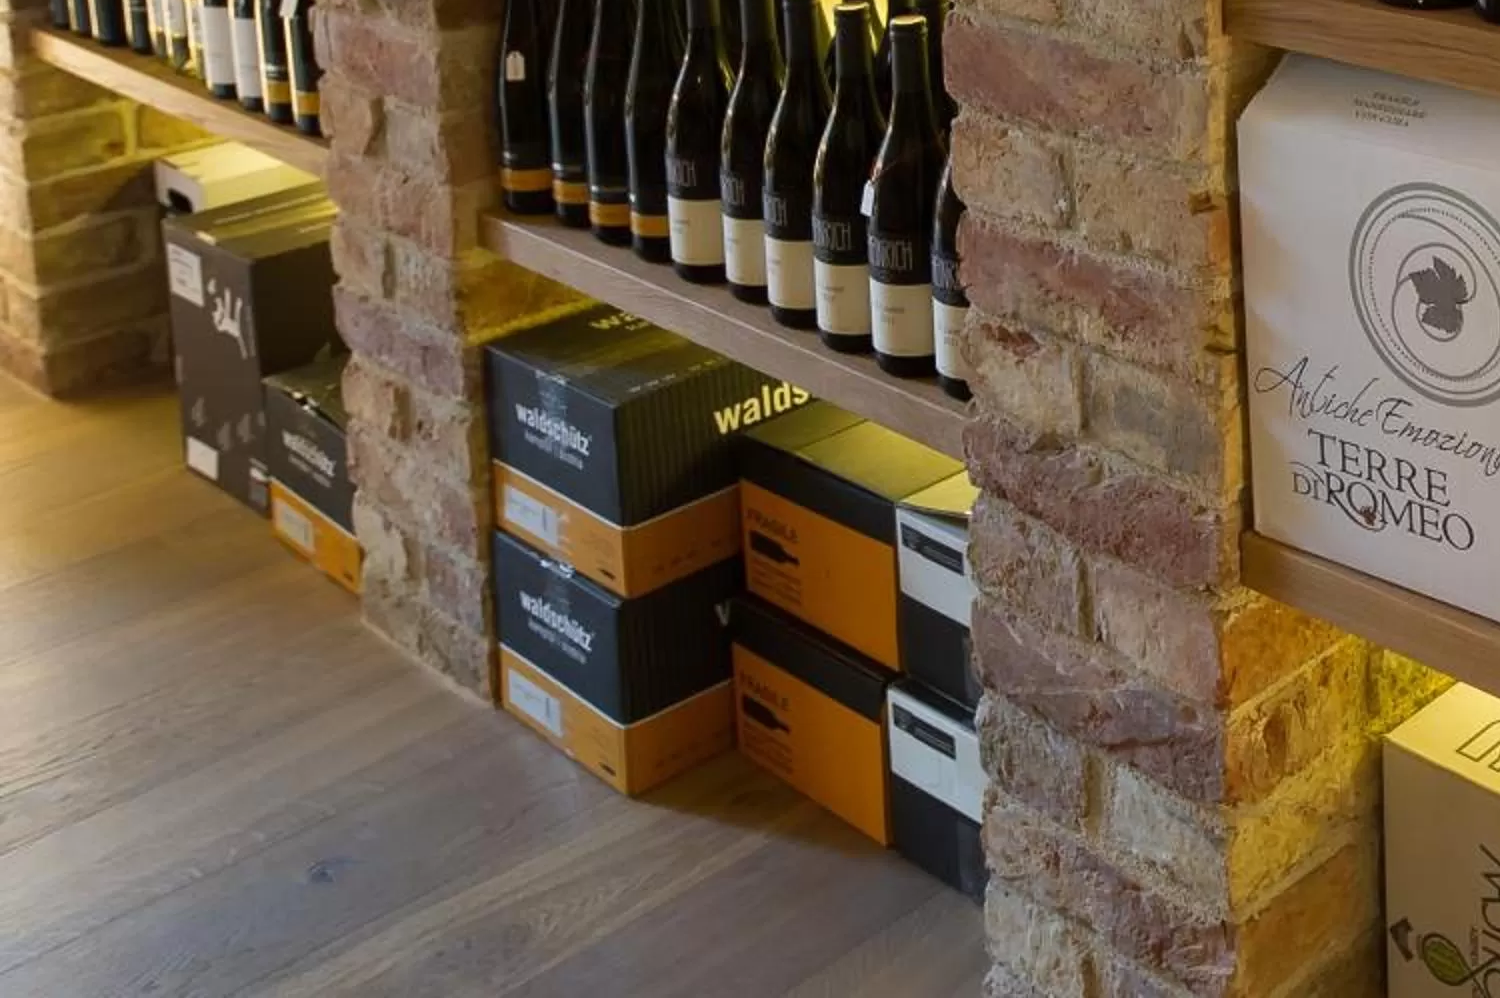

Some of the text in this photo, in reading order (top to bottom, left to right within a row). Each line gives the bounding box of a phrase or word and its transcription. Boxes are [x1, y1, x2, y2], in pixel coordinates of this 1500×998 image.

[1253, 356, 1374, 427] Antiche
[1307, 428, 1451, 507] TERRE
[1324, 469, 1475, 552] ROMEO
